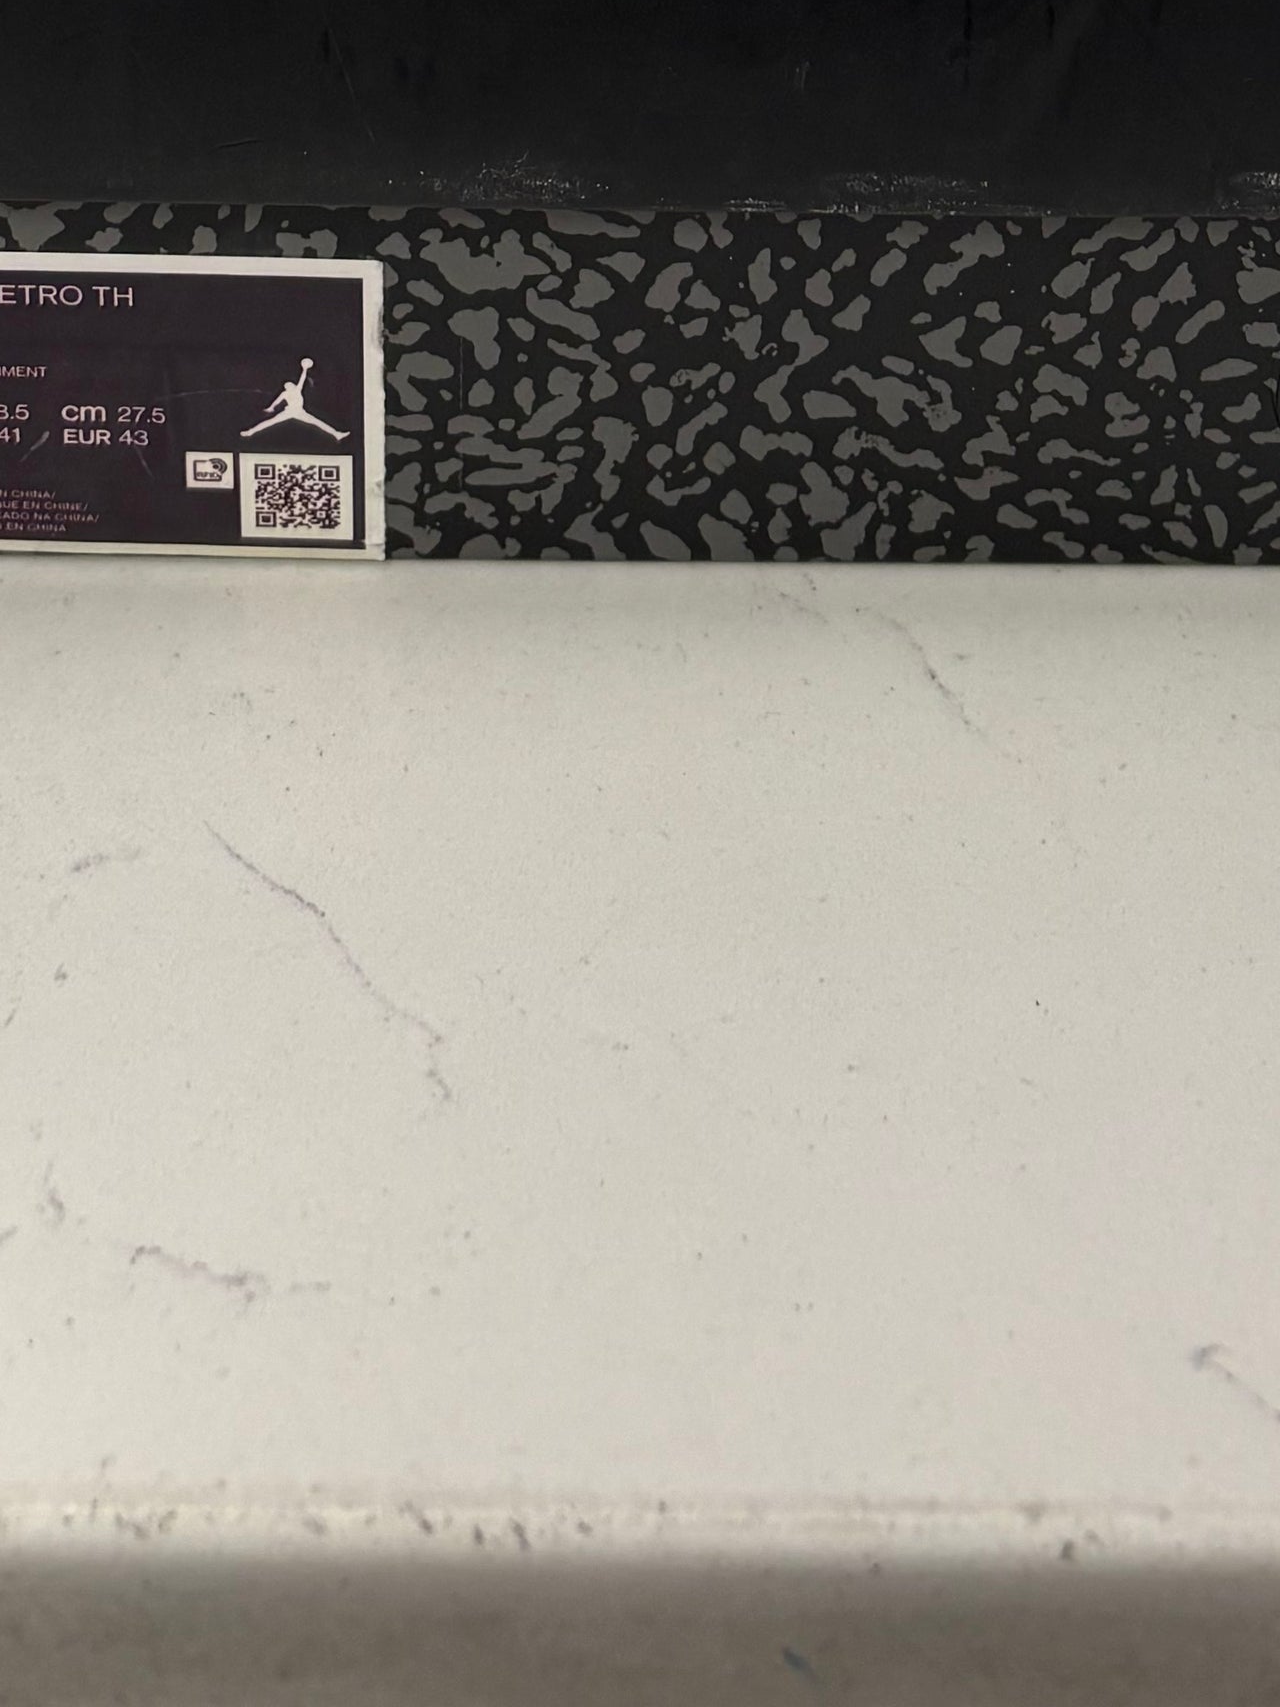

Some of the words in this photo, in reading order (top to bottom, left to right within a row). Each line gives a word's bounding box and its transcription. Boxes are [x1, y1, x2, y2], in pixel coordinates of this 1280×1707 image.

[91, 285, 135, 308] TH
[60, 404, 107, 423] cm
[117, 406, 166, 424] 27.5
[63, 428, 111, 445] EUR
[118, 429, 149, 446] 43
[23, 500, 41, 510] EN
